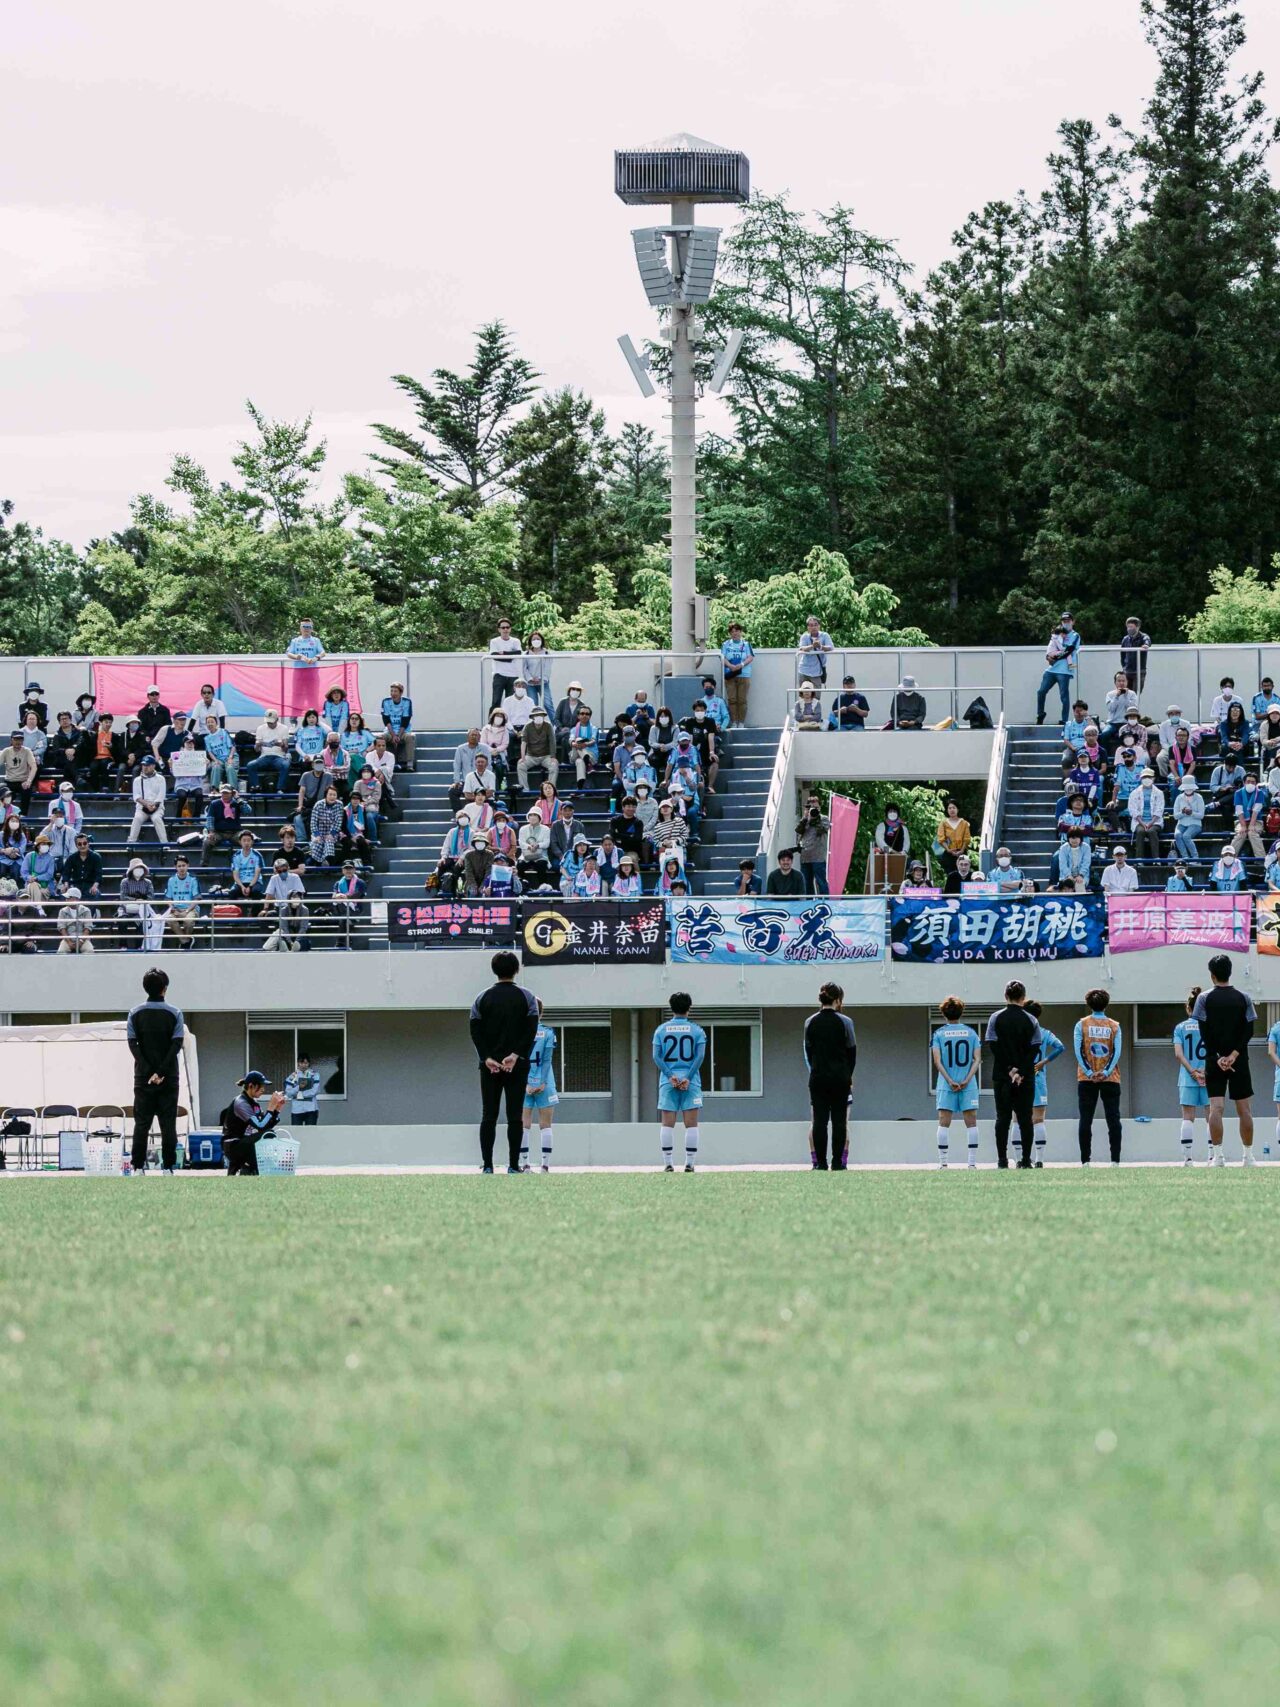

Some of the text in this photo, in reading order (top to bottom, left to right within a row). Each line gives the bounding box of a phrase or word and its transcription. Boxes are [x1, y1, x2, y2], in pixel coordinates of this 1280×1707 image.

[398, 907, 411, 925] 3
[675, 902, 847, 956] 菅百花
[909, 901, 1089, 946] 須田胡桃
[1113, 906, 1226, 936] 井原美波
[407, 927, 442, 936] STRONG!
[468, 927, 493, 935] SMILE!
[564, 919, 660, 946] 金井奈苗
[573, 946, 650, 955] NANAE KANAI
[784, 943, 879, 961] SUGA MOMOKA
[942, 947, 1058, 960] SUDA KURUMI
[663, 1035, 695, 1062] 20
[944, 1039, 970, 1068] 10
[1184, 1033, 1207, 1060] 16
